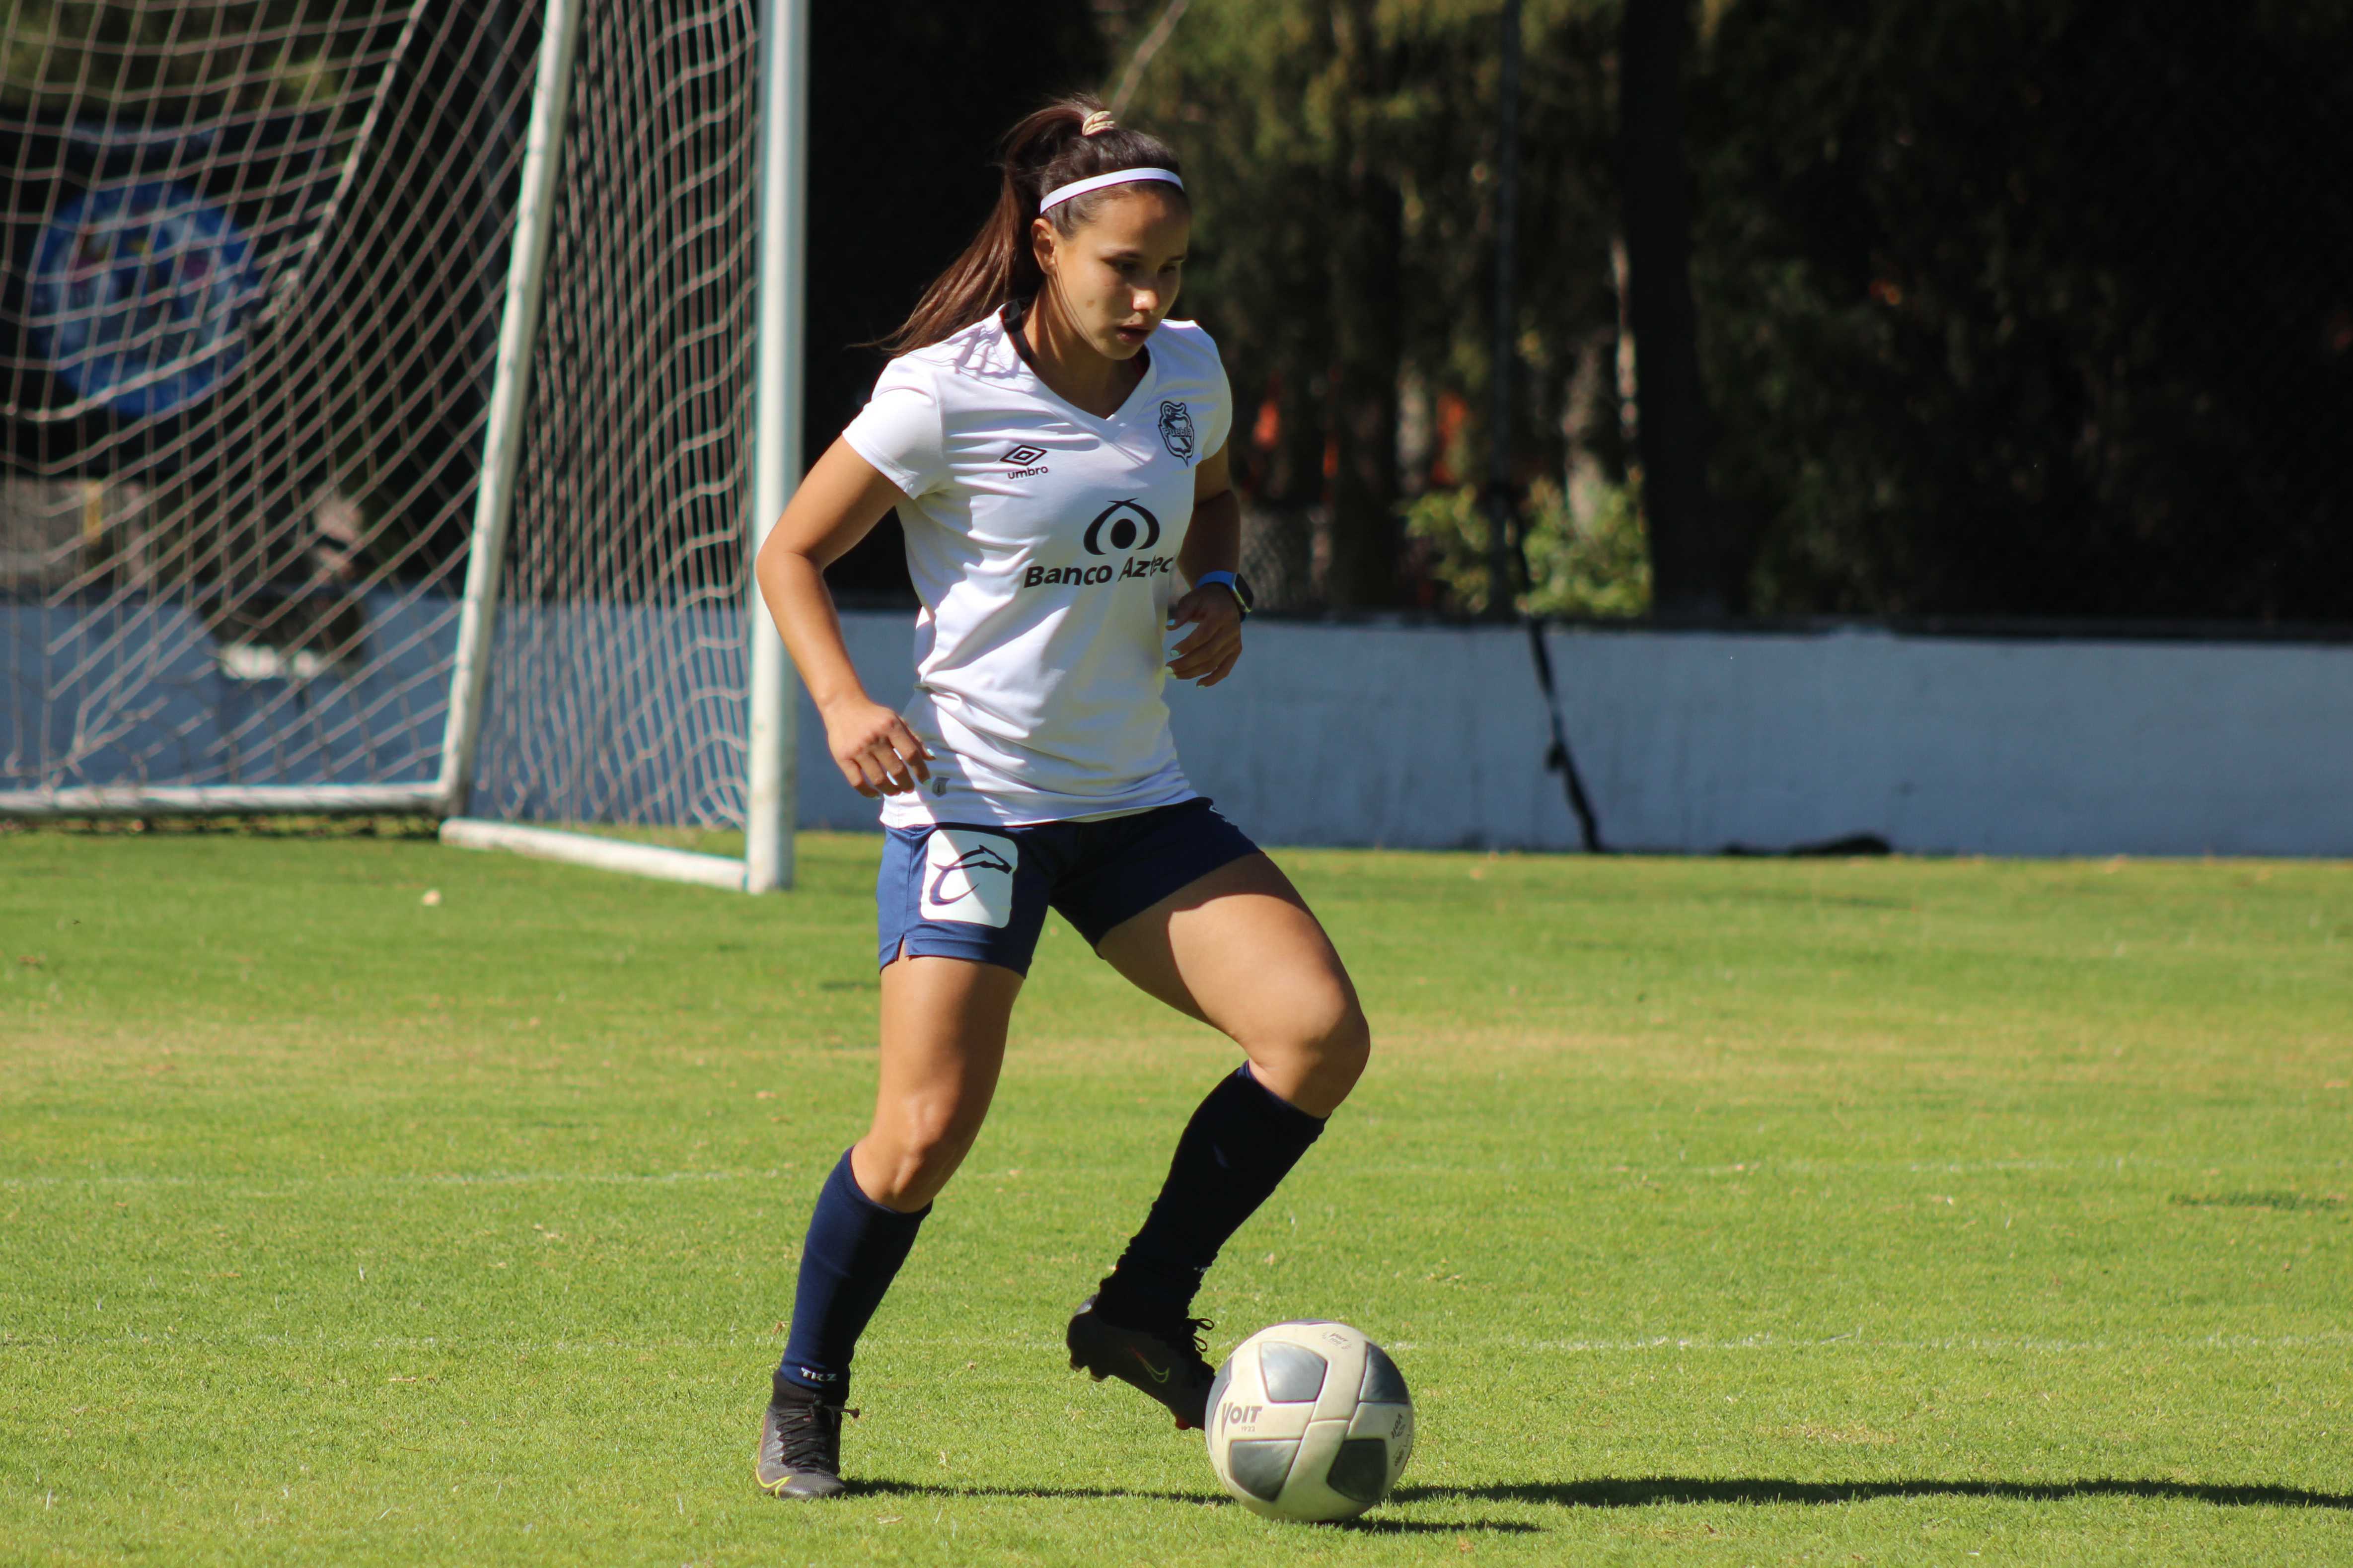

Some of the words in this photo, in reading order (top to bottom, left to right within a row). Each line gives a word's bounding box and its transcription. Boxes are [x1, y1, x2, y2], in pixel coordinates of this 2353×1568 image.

[1163, 426, 1192, 437] Puebla
[1007, 466, 1049, 480] umbro
[1024, 564, 1113, 588] Banco
[1117, 554, 1174, 582] Aztec
[1221, 1402, 1263, 1441] VOIT
